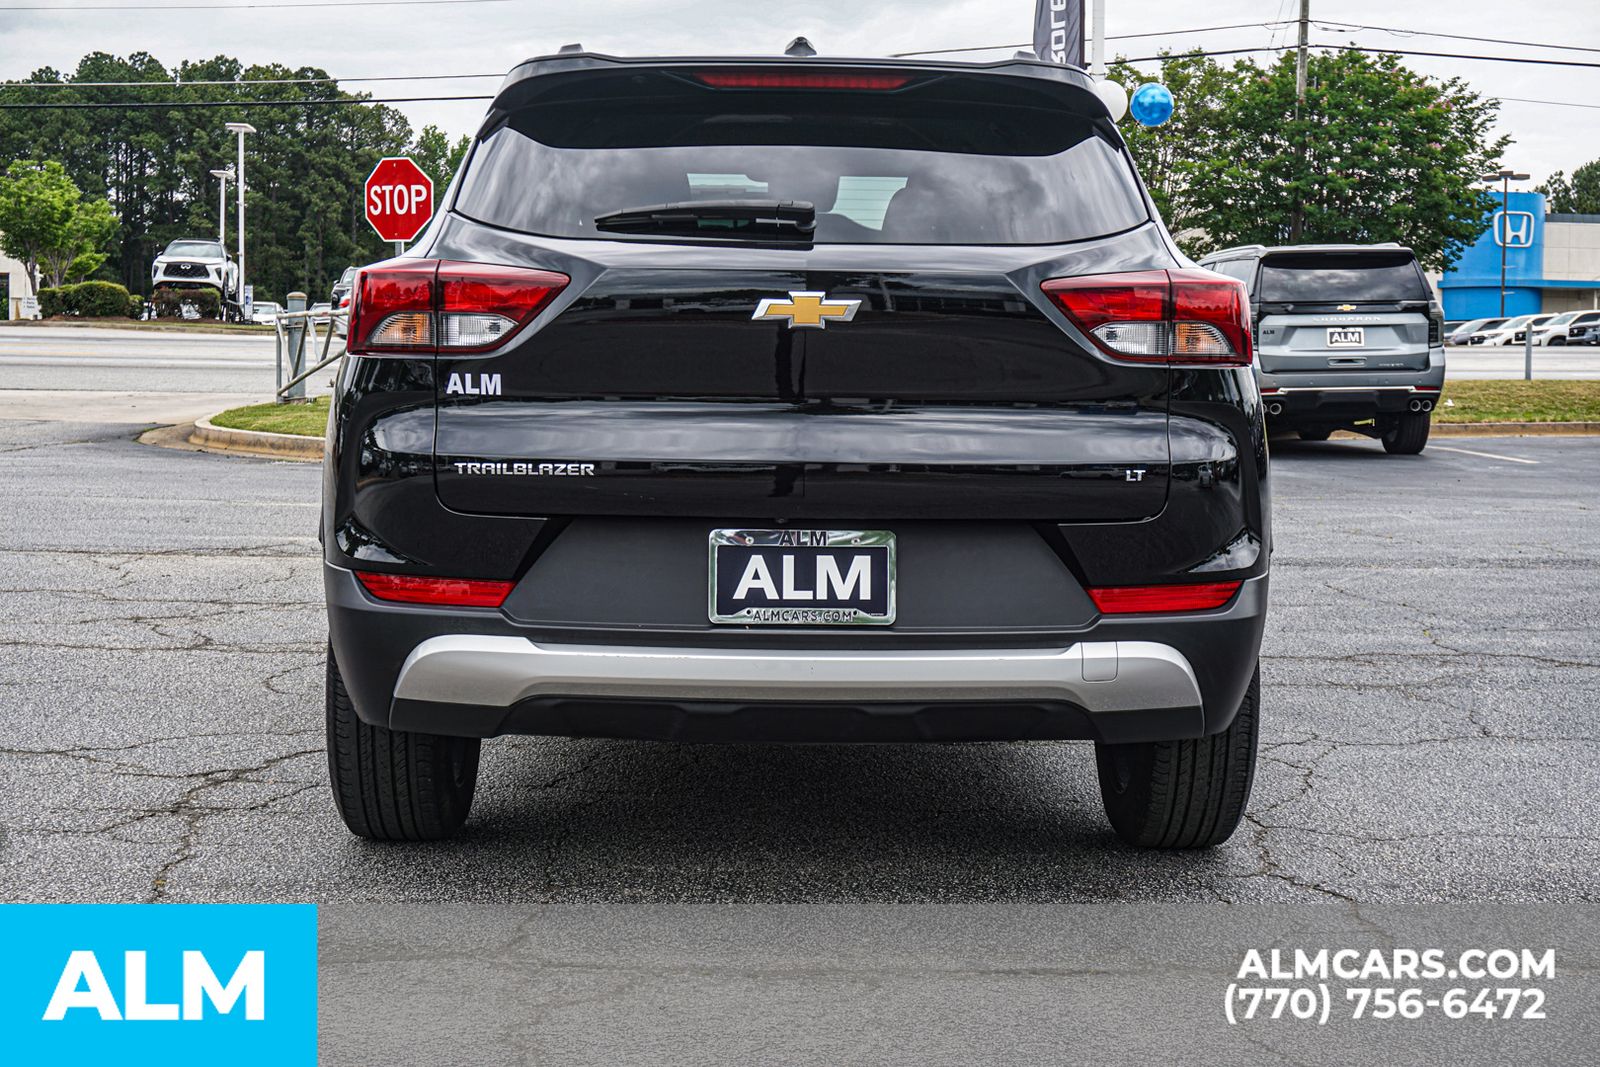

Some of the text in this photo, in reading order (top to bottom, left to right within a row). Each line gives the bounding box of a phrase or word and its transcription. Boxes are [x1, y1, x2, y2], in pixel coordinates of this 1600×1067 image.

[369, 184, 428, 216] STOP
[1331, 332, 1360, 343] ALM
[446, 373, 502, 395] ALM
[454, 462, 595, 476] TRAILBLAZER
[1126, 469, 1146, 481] LT
[779, 531, 829, 547] ALM
[732, 554, 871, 601] ALM
[752, 609, 854, 623] ALMCARS.COM
